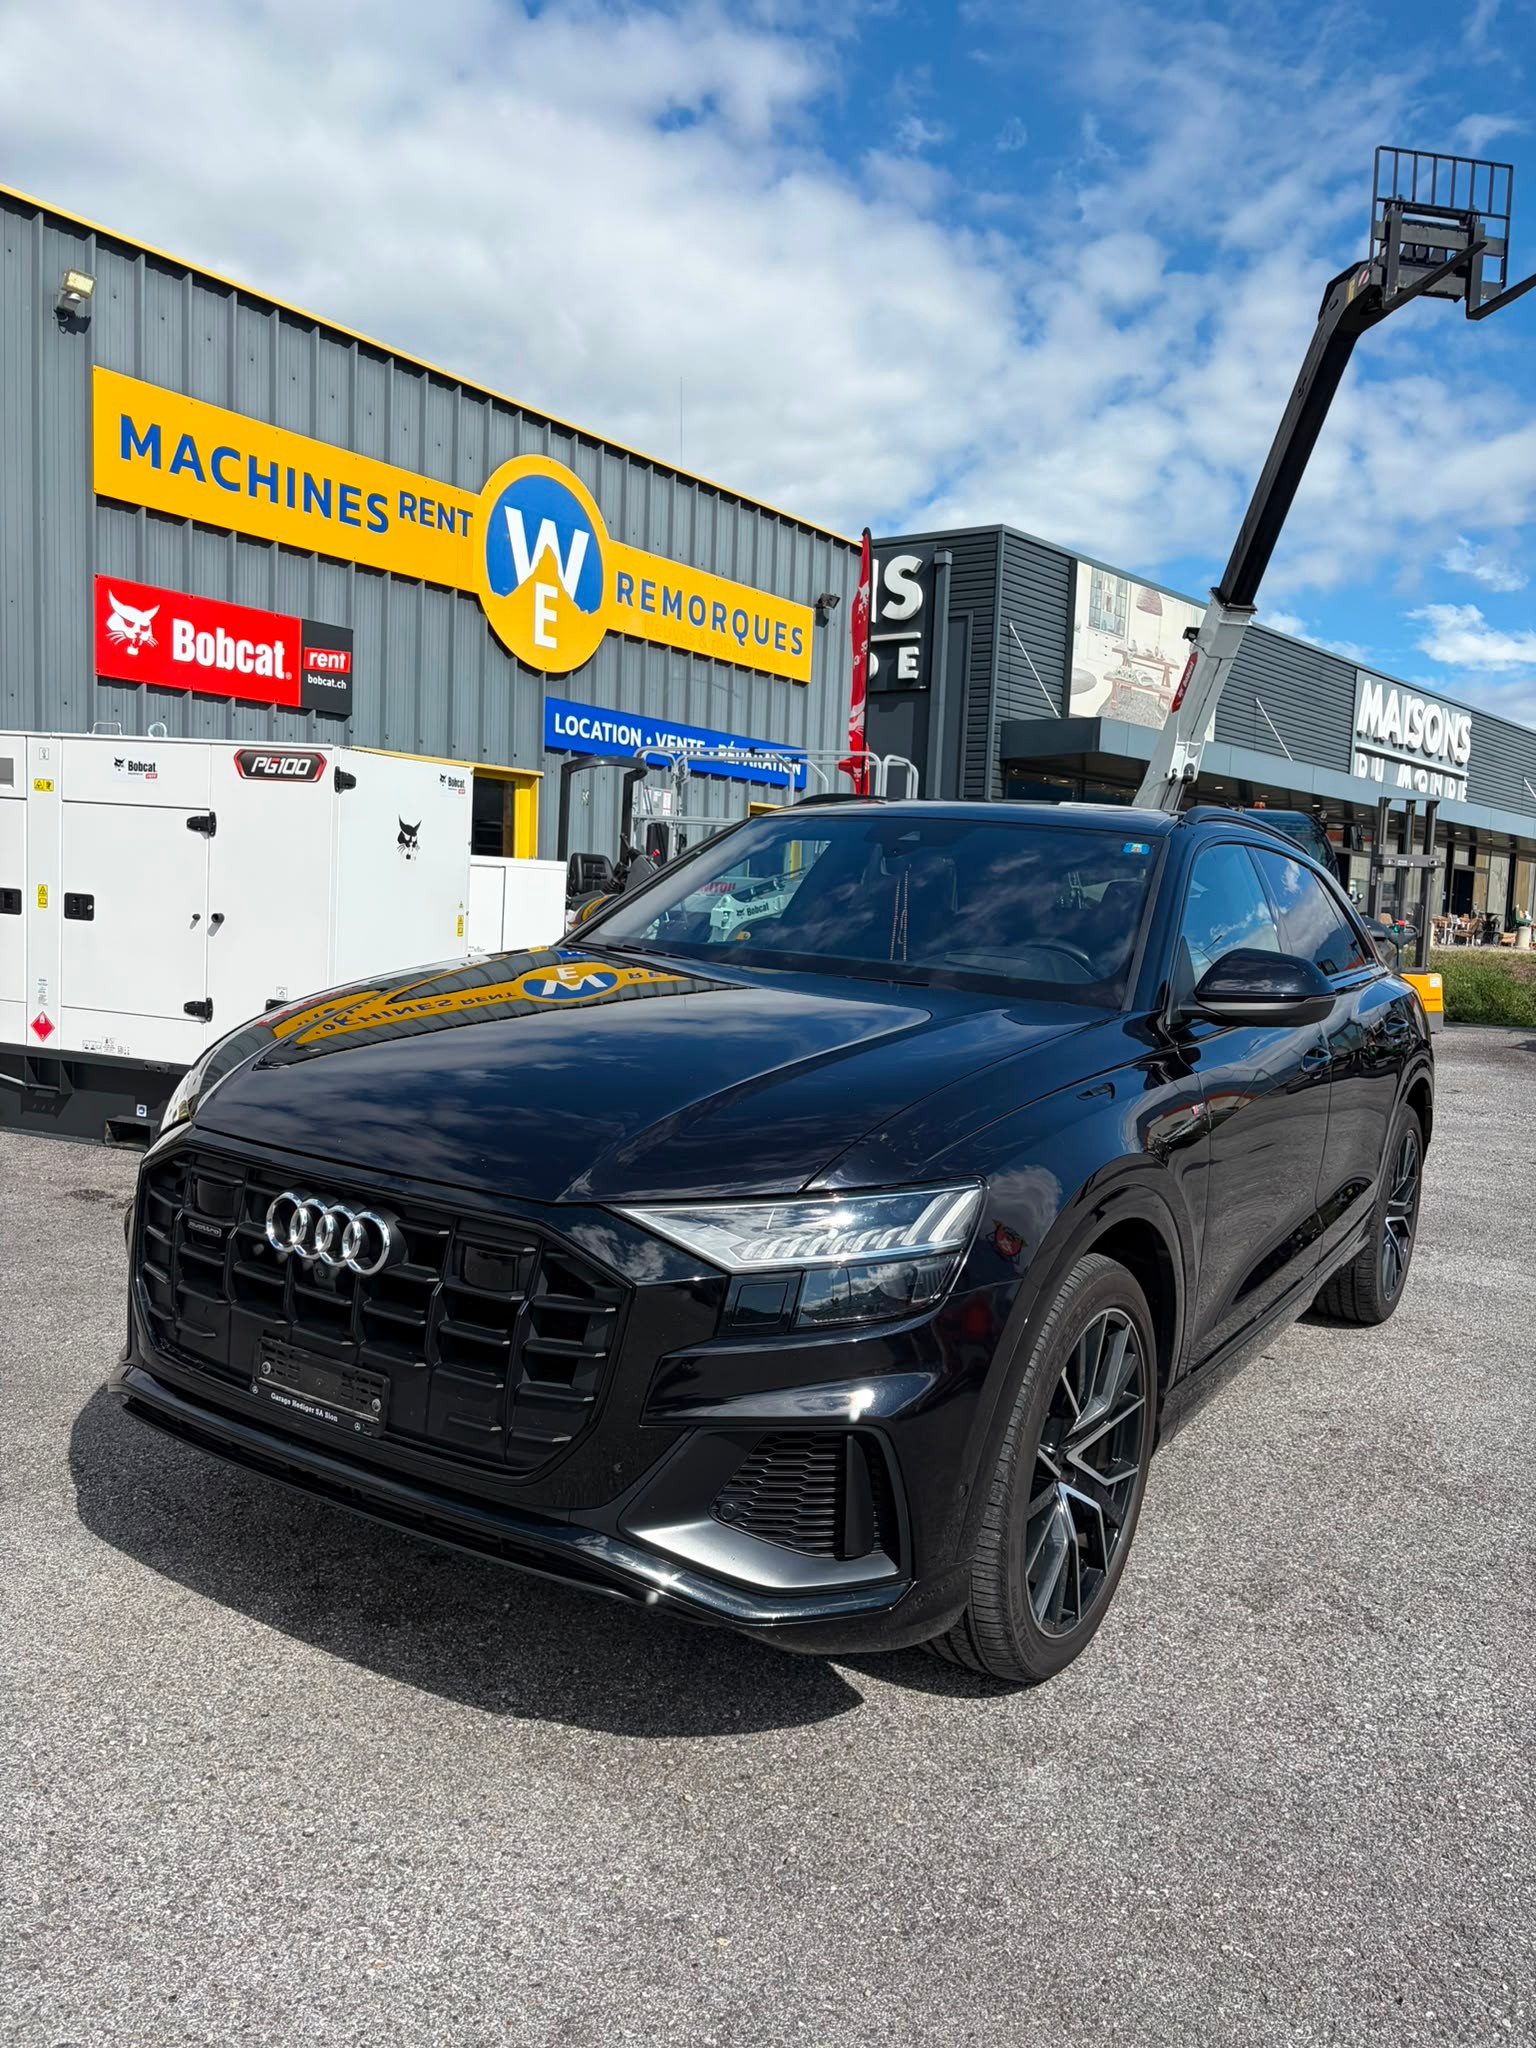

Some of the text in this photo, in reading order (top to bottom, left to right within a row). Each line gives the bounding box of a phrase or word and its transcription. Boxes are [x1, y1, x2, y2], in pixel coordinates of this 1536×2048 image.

[120, 413, 474, 538] MACHINES RENT
[616, 570, 803, 655] REMORQUES
[172, 618, 347, 680] Bobcat rent
[307, 673, 347, 690] bobcat.ch
[554, 713, 642, 748] LOCATION
[655, 731, 706, 758] VENTE
[1356, 679, 1473, 765] MAISONS
[128, 760, 156, 773] Bobcat
[251, 756, 311, 776] PG100
[1353, 752, 1468, 804] DU MONDE
[746, 903, 769, 917] Bobcat
[270, 1392, 291, 1406] Garage
